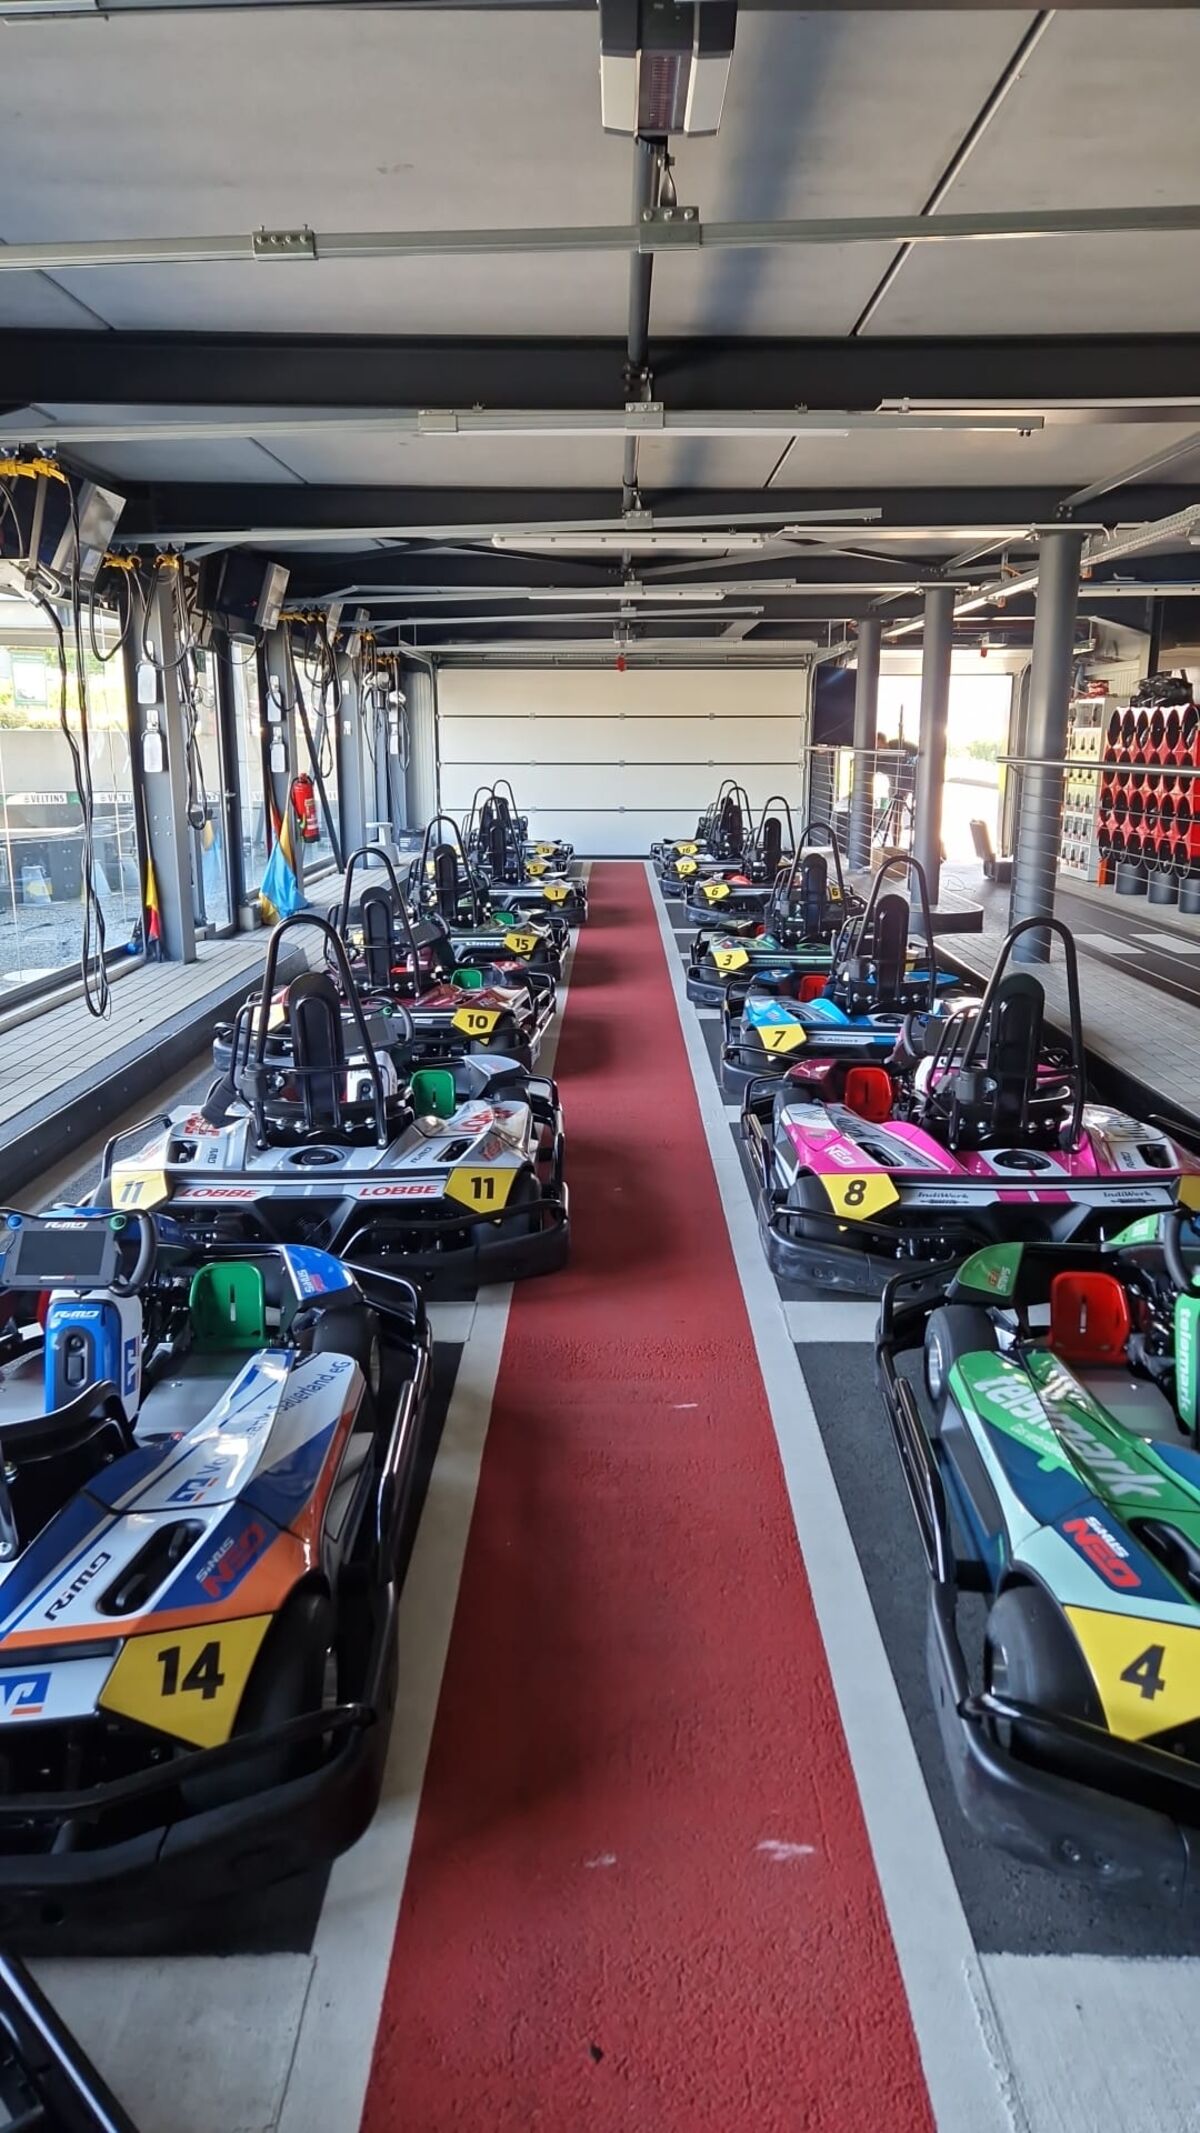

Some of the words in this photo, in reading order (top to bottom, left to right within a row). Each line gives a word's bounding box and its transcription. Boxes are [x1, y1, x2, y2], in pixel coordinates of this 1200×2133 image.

[680, 864, 690, 872] 12
[711, 887, 720, 896] 6
[515, 938, 529, 950] 15
[723, 954, 733, 966] 3
[467, 1014, 489, 1029] 10
[772, 1030, 787, 1047] 7
[120, 1180, 145, 1204] 11
[179, 1188, 261, 1198] LOBBE
[359, 1184, 439, 1197] LOBBE
[470, 1177, 495, 1200] 11
[844, 1179, 867, 1207] 8
[1179, 1307, 1192, 1413] telemark
[157, 1640, 226, 1701] 14
[1120, 1643, 1166, 1701] 4
